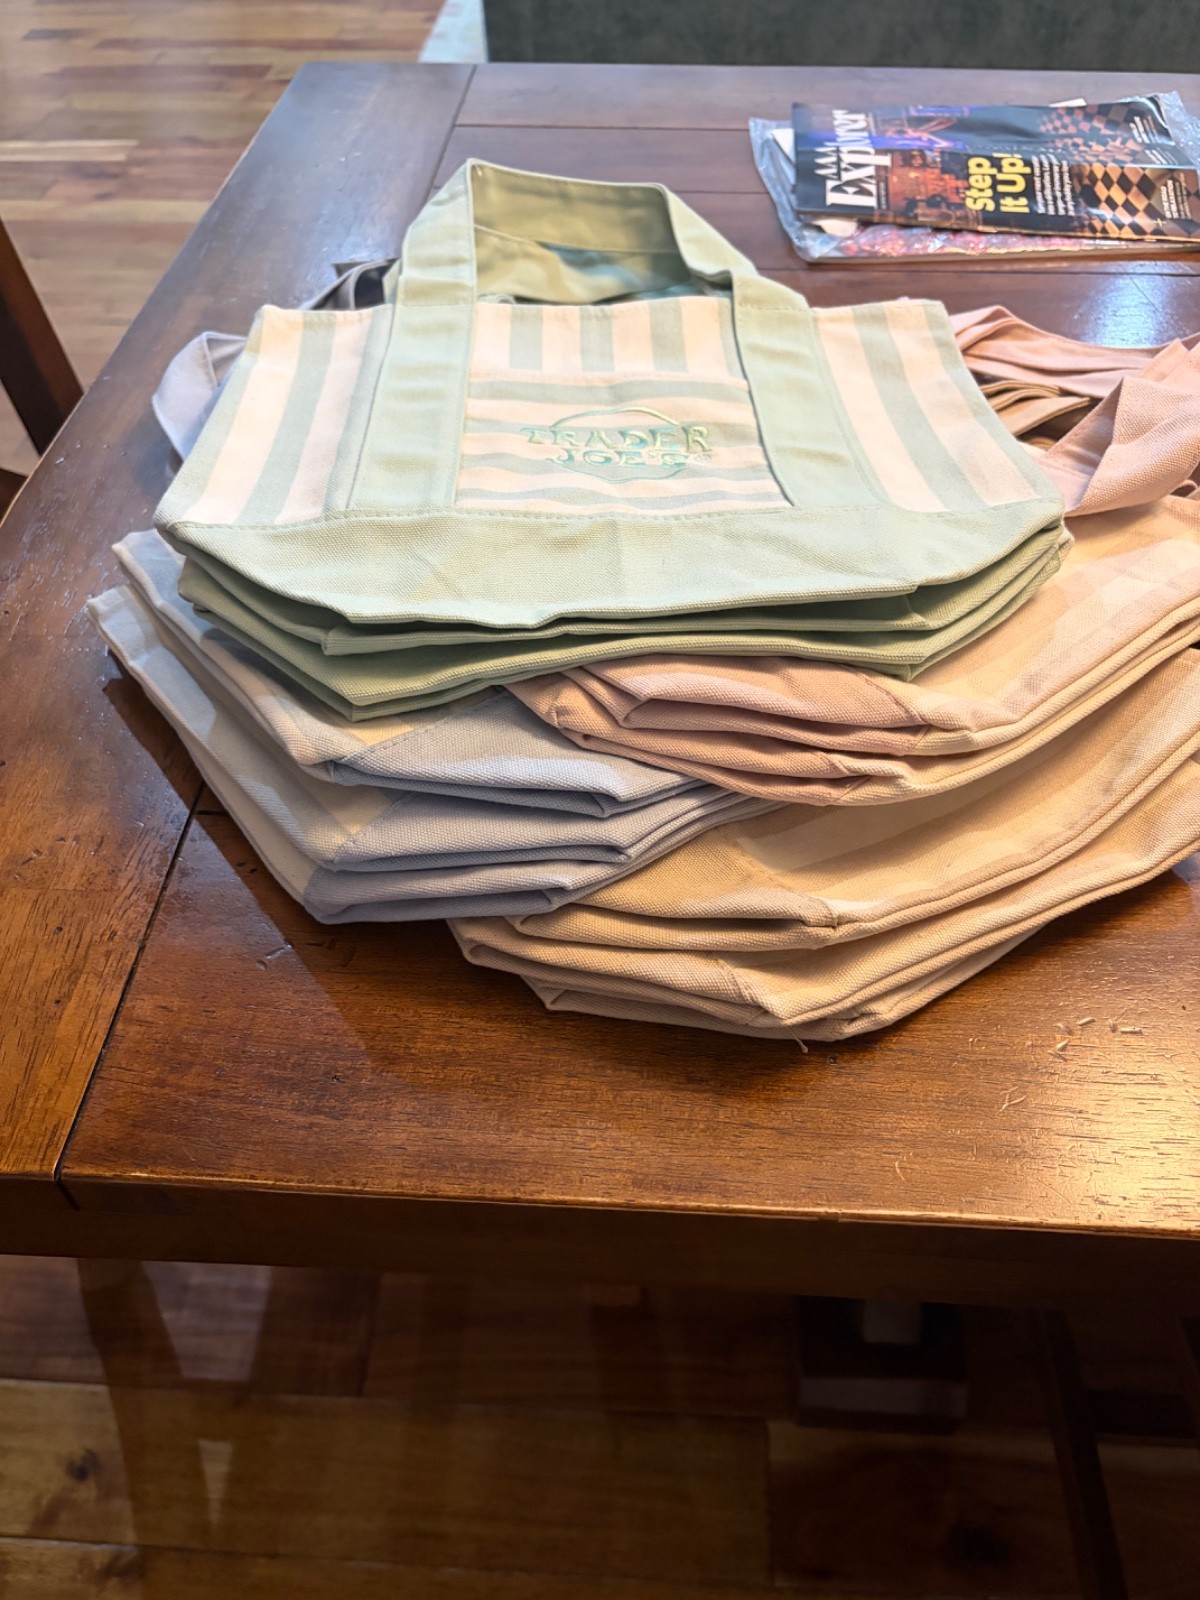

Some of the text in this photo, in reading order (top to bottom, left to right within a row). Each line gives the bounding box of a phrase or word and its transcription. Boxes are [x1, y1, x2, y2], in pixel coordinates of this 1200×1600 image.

[814, 147, 838, 178] AAA
[965, 156, 998, 212] Step
[999, 196, 1030, 213] It
[520, 424, 713, 454] TRADER
[545, 448, 690, 467] JOE'S
